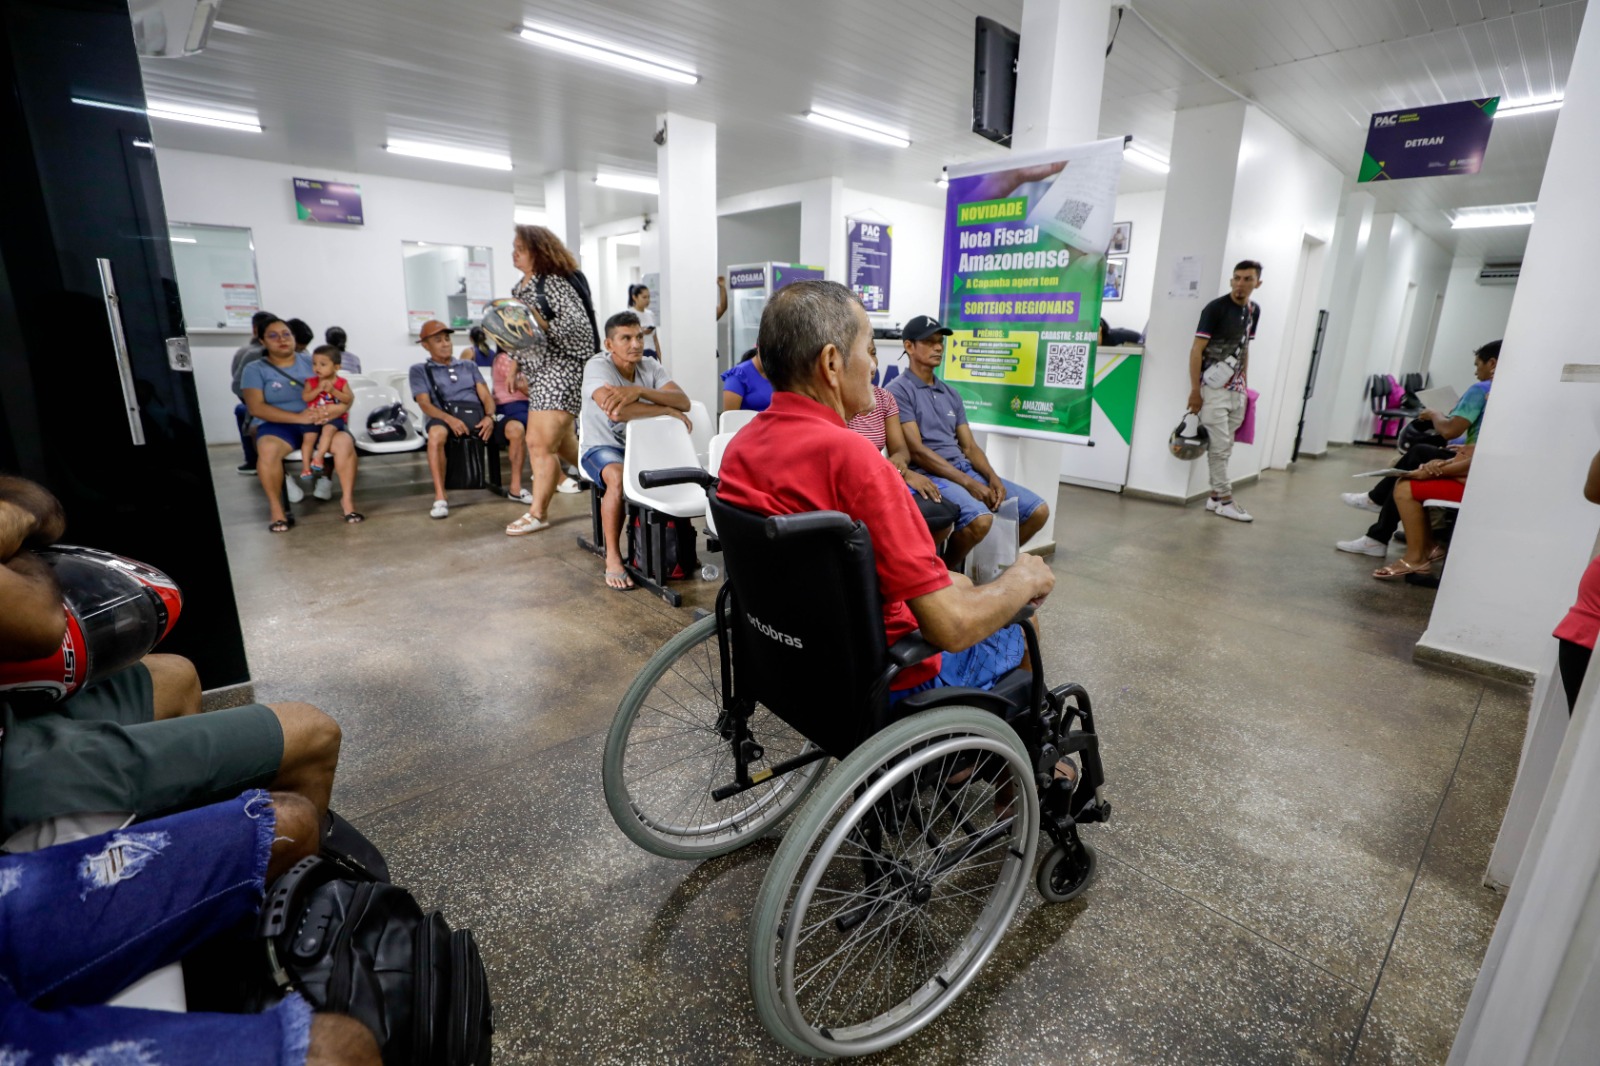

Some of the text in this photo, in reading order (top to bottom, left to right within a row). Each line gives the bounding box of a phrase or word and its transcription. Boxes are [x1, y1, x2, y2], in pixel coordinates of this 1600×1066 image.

[1374, 114, 1398, 127] PAC
[1404, 136, 1444, 148] DETRAN
[960, 201, 1023, 221] NOVIDADE
[861, 223, 880, 237] PAC
[959, 230, 992, 249] Nota
[993, 225, 1040, 247] Fiscal
[958, 249, 1070, 273] Amazonense
[736, 272, 764, 283] COSAMA
[965, 278, 972, 289] A
[1011, 277, 1038, 289] agora
[1040, 276, 1059, 286] tem
[964, 300, 1075, 315] SORTEIOS REGIONAIS
[1040, 331, 1072, 340] CADASTRE
[1075, 331, 1084, 341] SE
[1022, 400, 1054, 412] AMAZONAS
